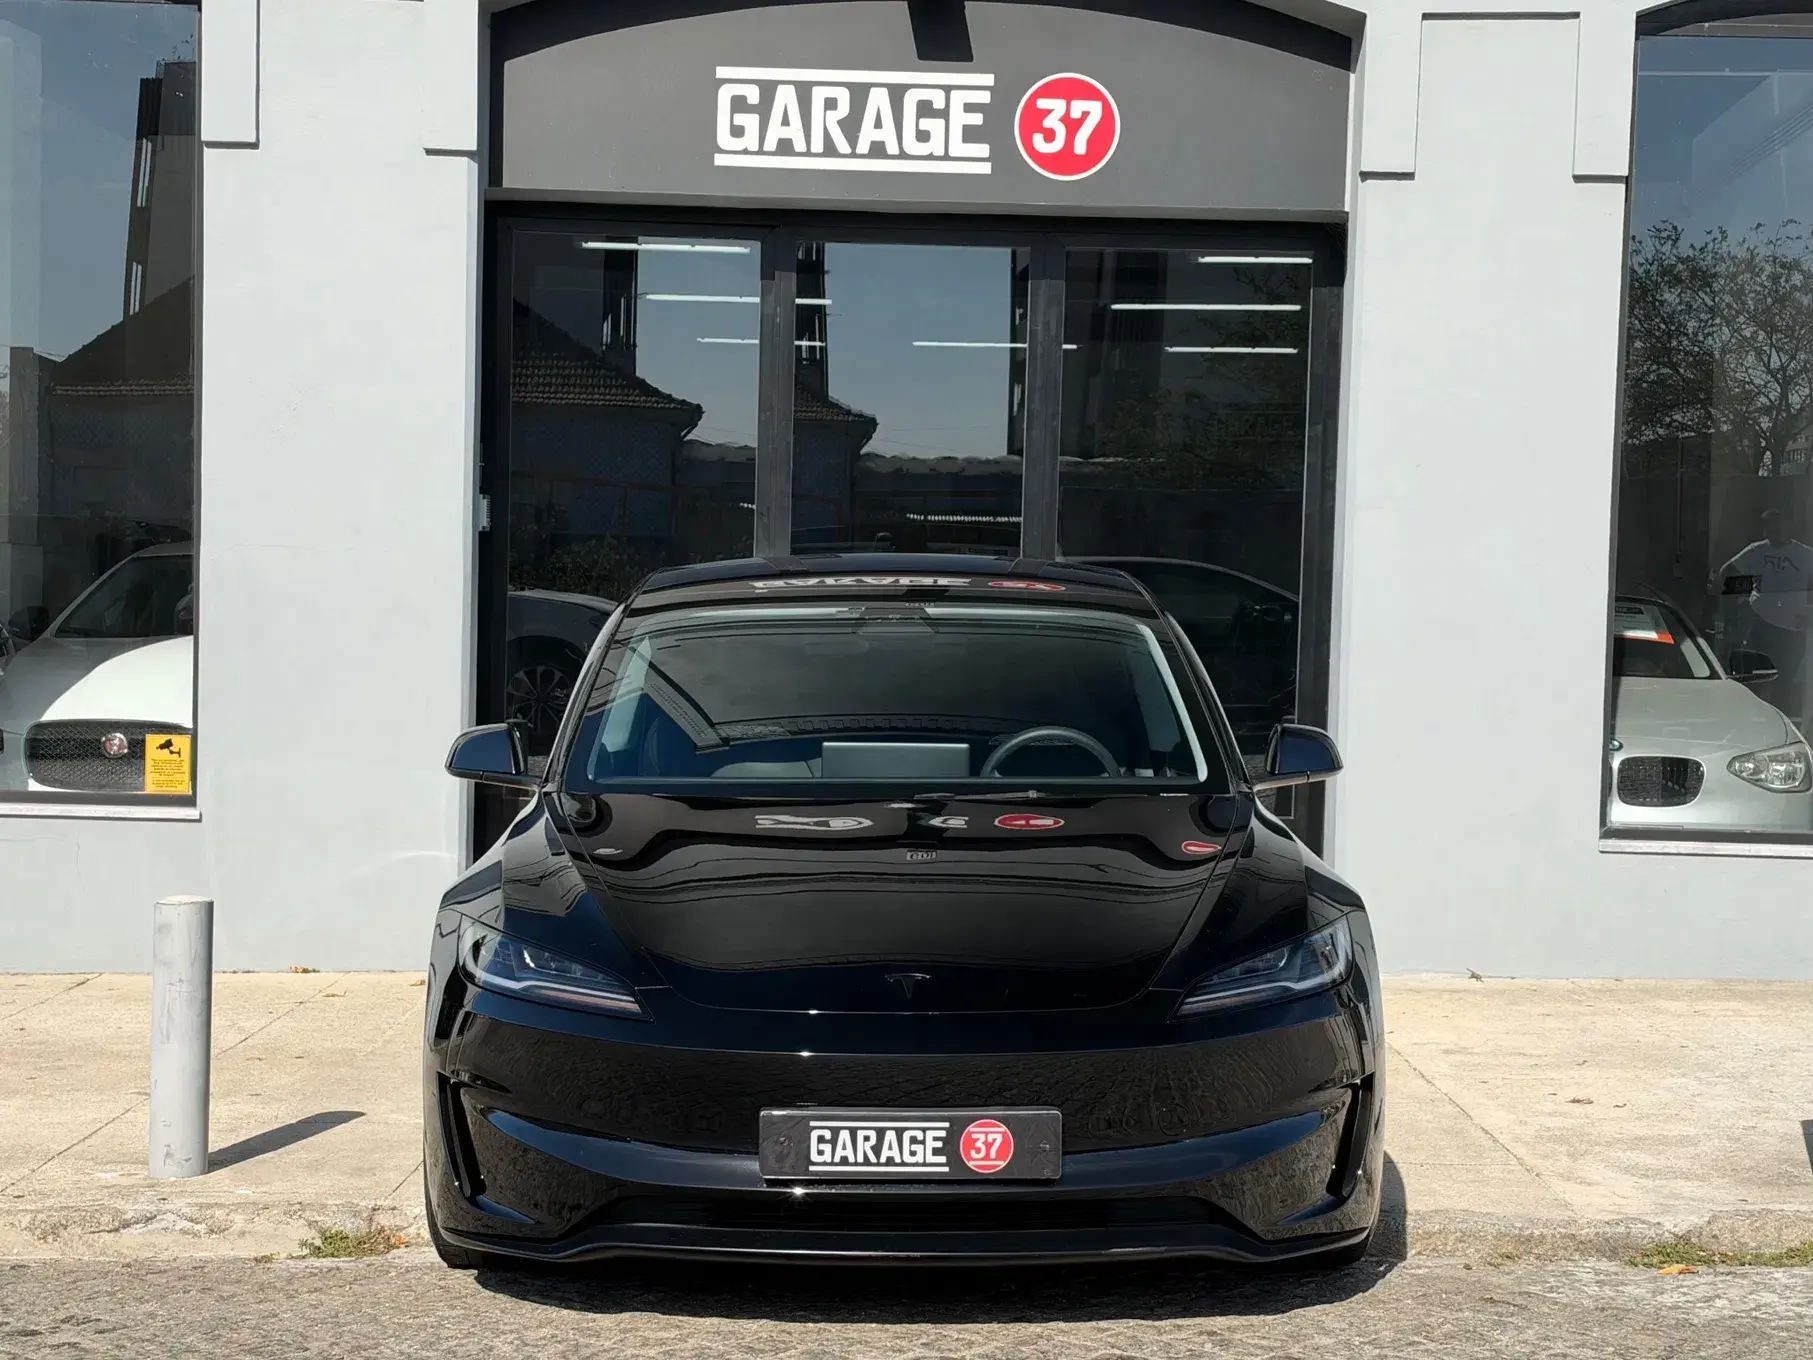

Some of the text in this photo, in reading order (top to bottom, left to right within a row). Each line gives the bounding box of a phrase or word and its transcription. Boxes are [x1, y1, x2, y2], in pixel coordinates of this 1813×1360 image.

[716, 83, 1102, 158] GARAGE 37
[810, 1129, 1004, 1163] GARAGE 37
